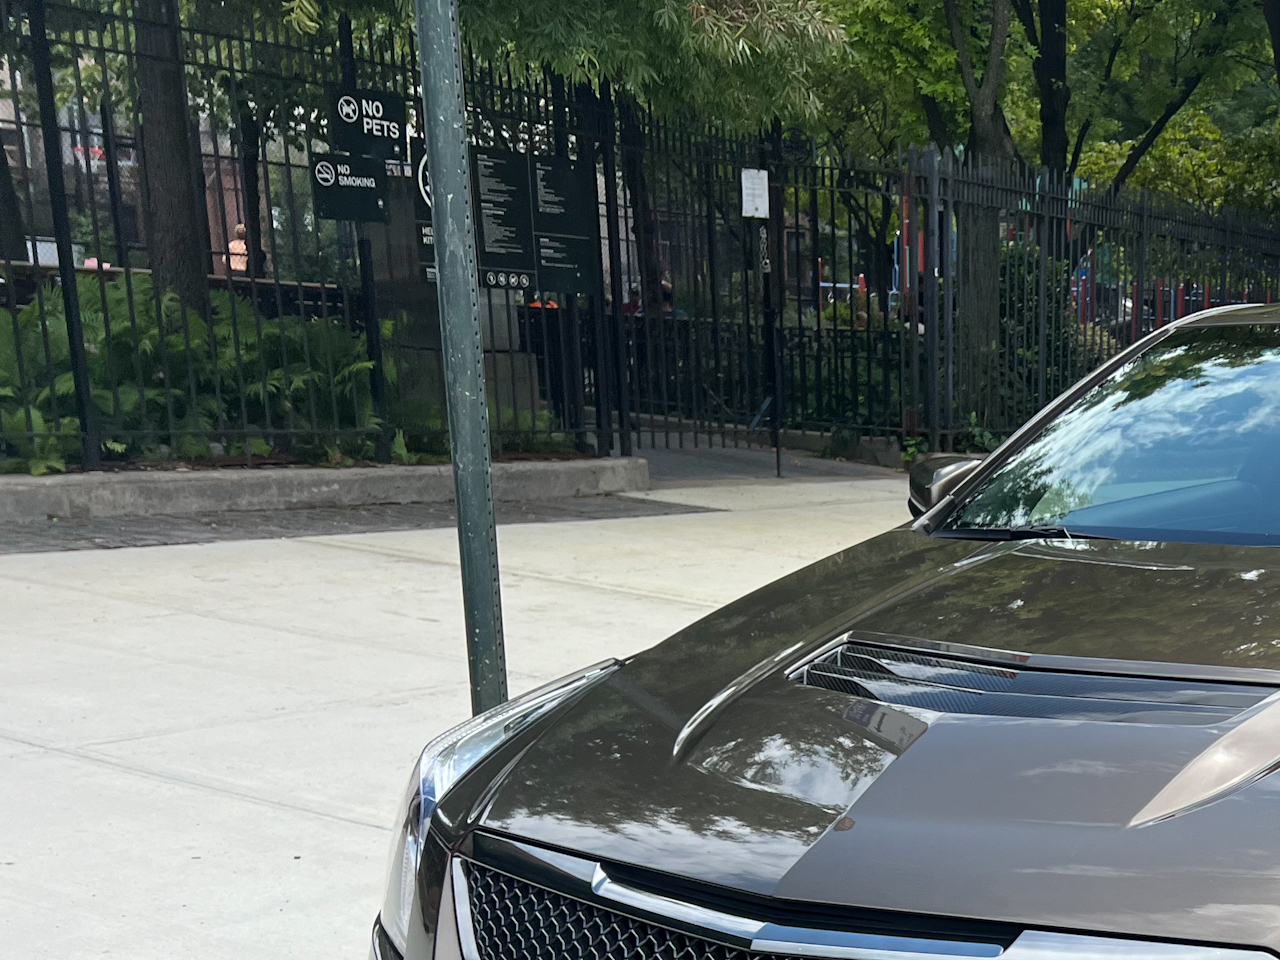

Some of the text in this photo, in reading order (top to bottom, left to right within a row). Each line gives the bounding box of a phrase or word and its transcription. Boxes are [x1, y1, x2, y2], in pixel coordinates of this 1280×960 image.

[361, 98, 383, 118] NO
[363, 117, 400, 139] PETS
[337, 164, 350, 175] NO
[338, 175, 376, 188] SMOKING
